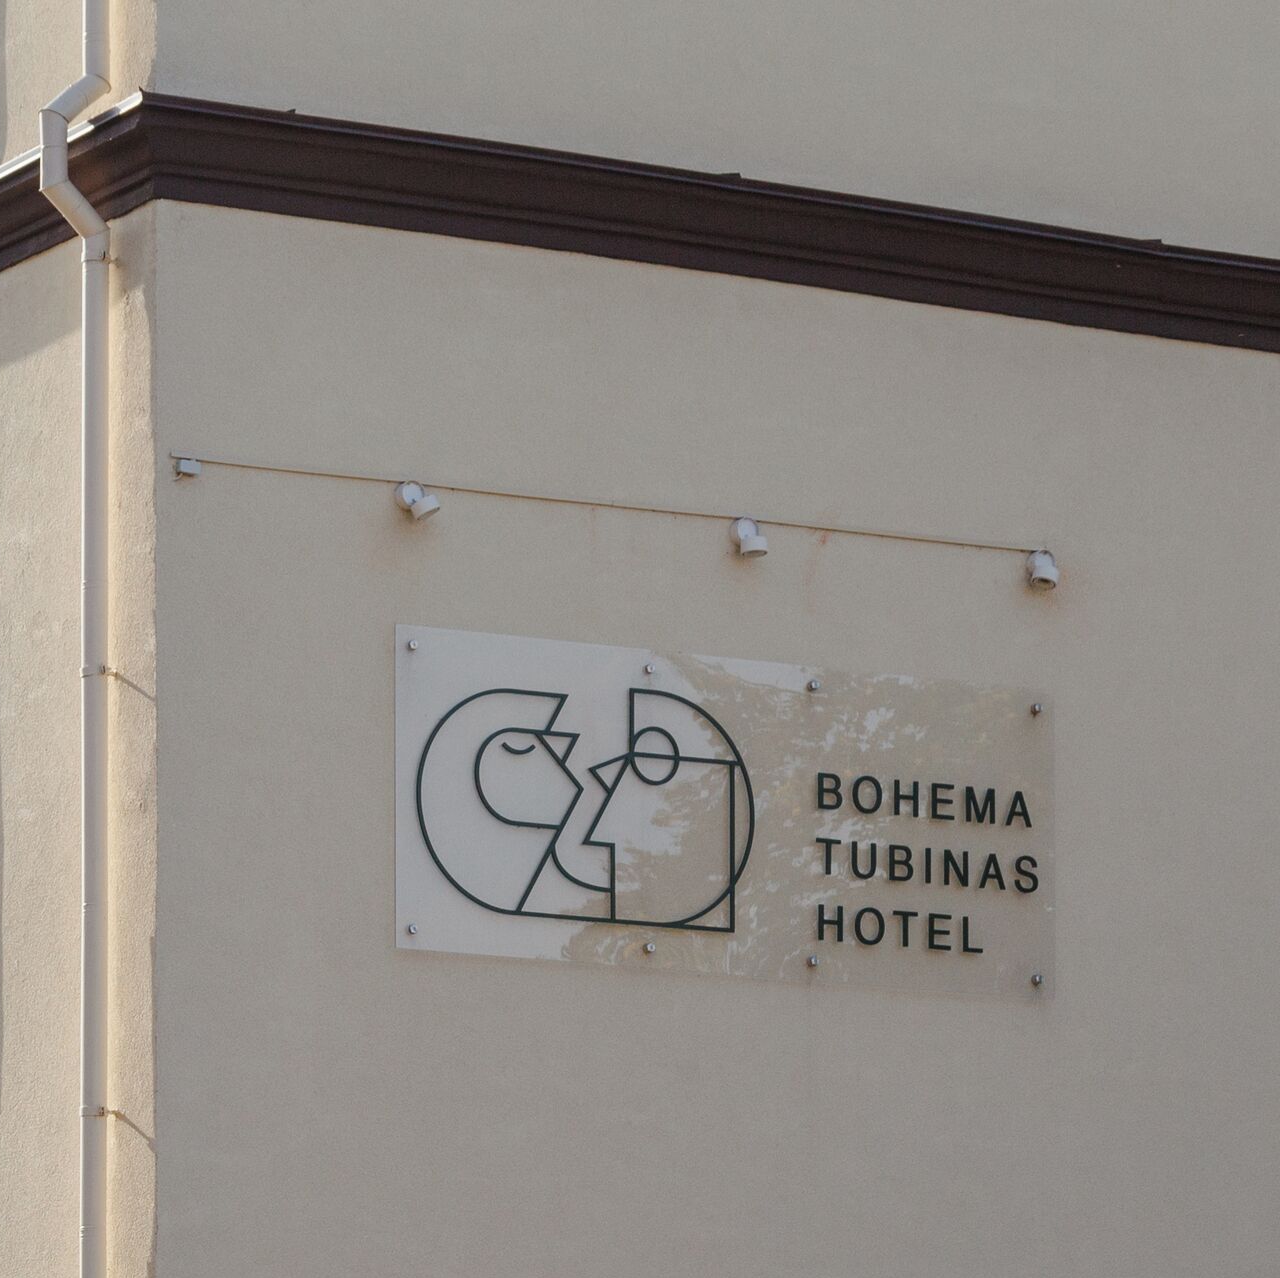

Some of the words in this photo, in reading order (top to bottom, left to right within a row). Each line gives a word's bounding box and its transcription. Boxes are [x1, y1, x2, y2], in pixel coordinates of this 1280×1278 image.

[816, 771, 1033, 829] BOHEMA
[815, 837, 1039, 895] TUBINAS
[817, 903, 984, 954] HOTEL
